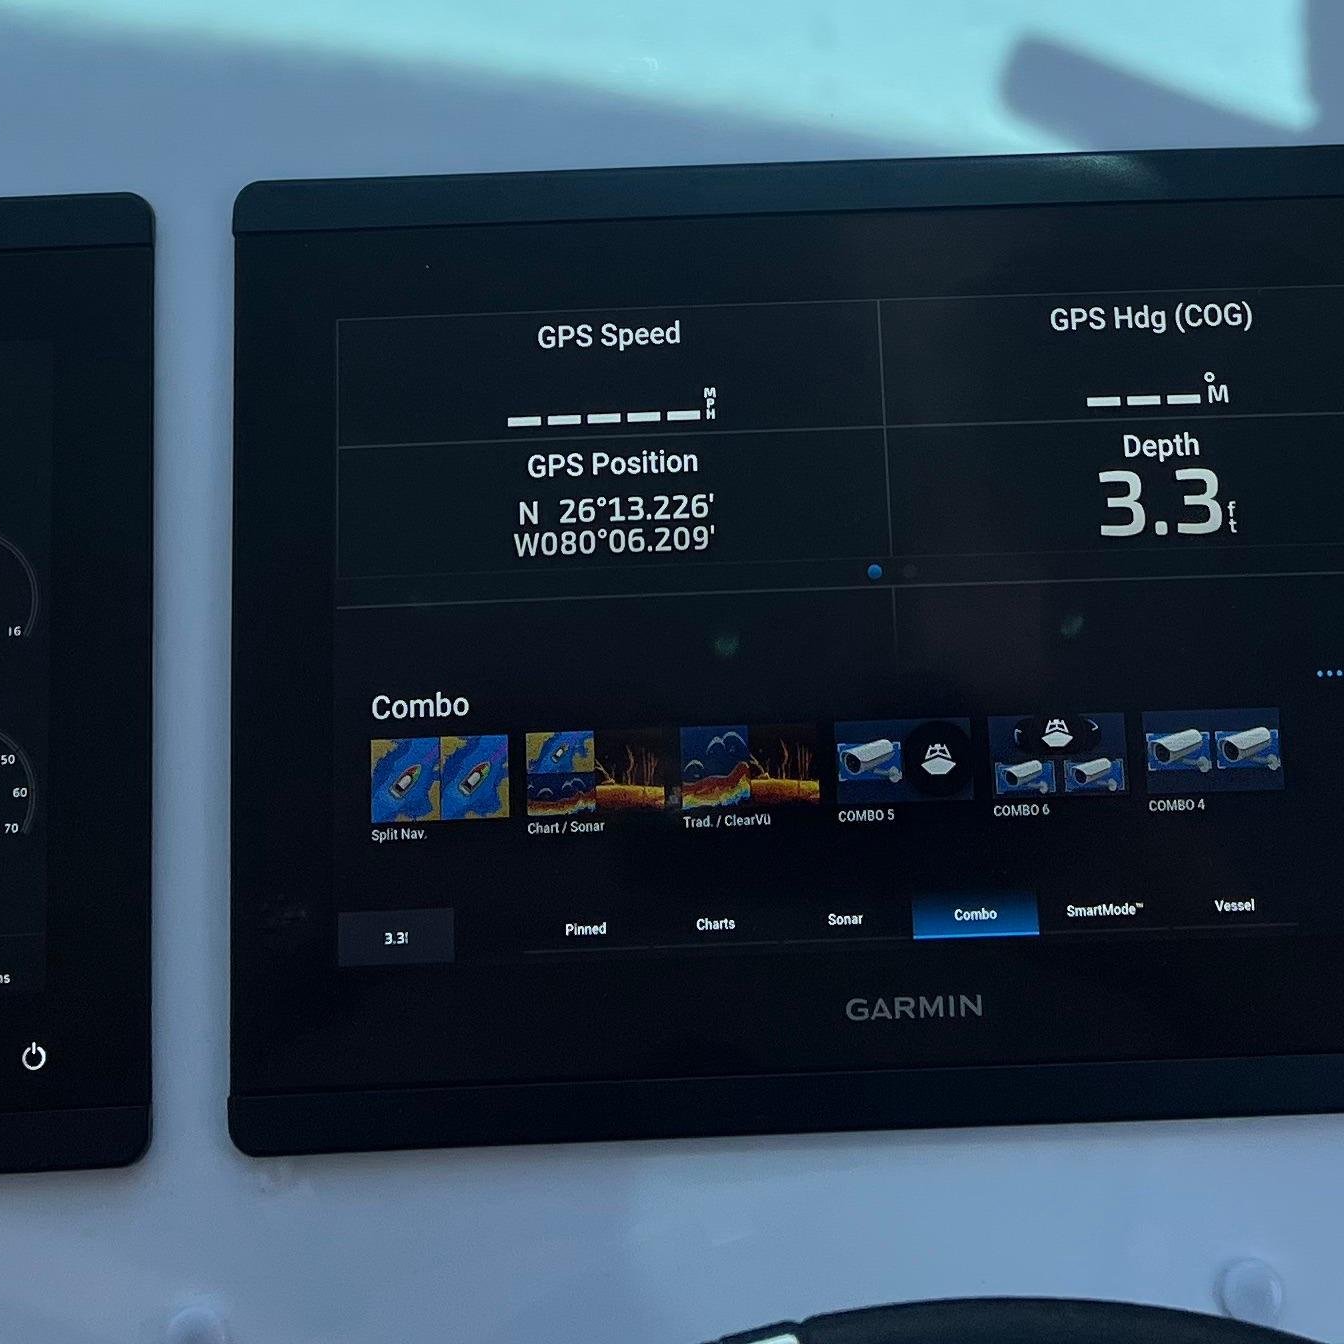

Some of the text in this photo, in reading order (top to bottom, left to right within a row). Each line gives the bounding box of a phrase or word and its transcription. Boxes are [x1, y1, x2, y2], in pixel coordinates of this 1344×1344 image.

[1050, 301, 1254, 334] GPS Hdg (COG)
[537, 321, 682, 351] GPS Speed
[1123, 432, 1200, 462] Depth
[527, 450, 699, 479] GPS Position
[519, 493, 714, 526] N 26°13.226'
[1098, 467, 1223, 536] 3.3
[513, 526, 714, 557] W080°06.209'
[9, 626, 21, 636] 16
[371, 691, 470, 721] Combo
[0, 754, 15, 765] 50
[13, 788, 27, 798] 60
[993, 803, 1050, 818] COMBO 6
[1148, 798, 1206, 813] COMBO 4
[682, 815, 714, 829] Trad.
[838, 808, 895, 823] COMBO 5
[4, 823, 18, 834] 70
[371, 826, 428, 843] Split Nav.
[527, 819, 606, 835] Chart Sonar
[1214, 898, 1255, 913] Vessel
[827, 912, 864, 927] Sonar
[954, 908, 998, 922] Combo
[564, 921, 607, 937] Pinned
[695, 916, 736, 932] Charts
[845, 994, 984, 1022] GARMIN
